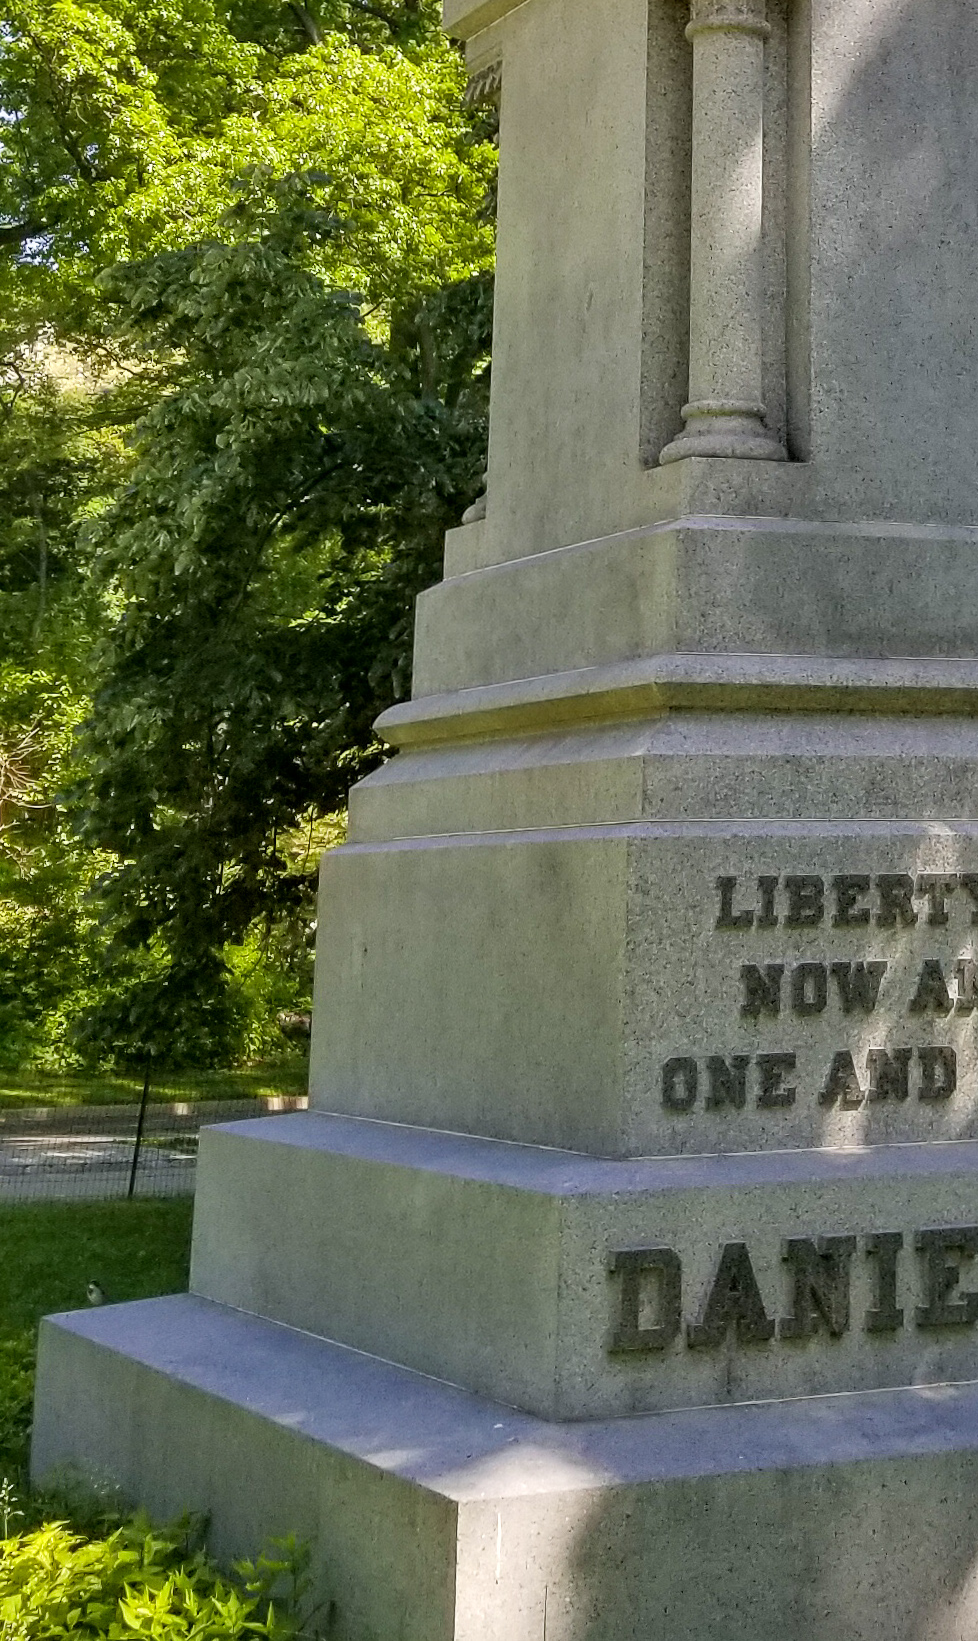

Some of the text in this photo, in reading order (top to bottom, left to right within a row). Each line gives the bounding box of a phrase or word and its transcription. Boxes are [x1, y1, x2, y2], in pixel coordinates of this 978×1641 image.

[740, 960, 888, 1019] NOW
[661, 1051, 797, 1111] ONE
[818, 1045, 957, 1111] AND
